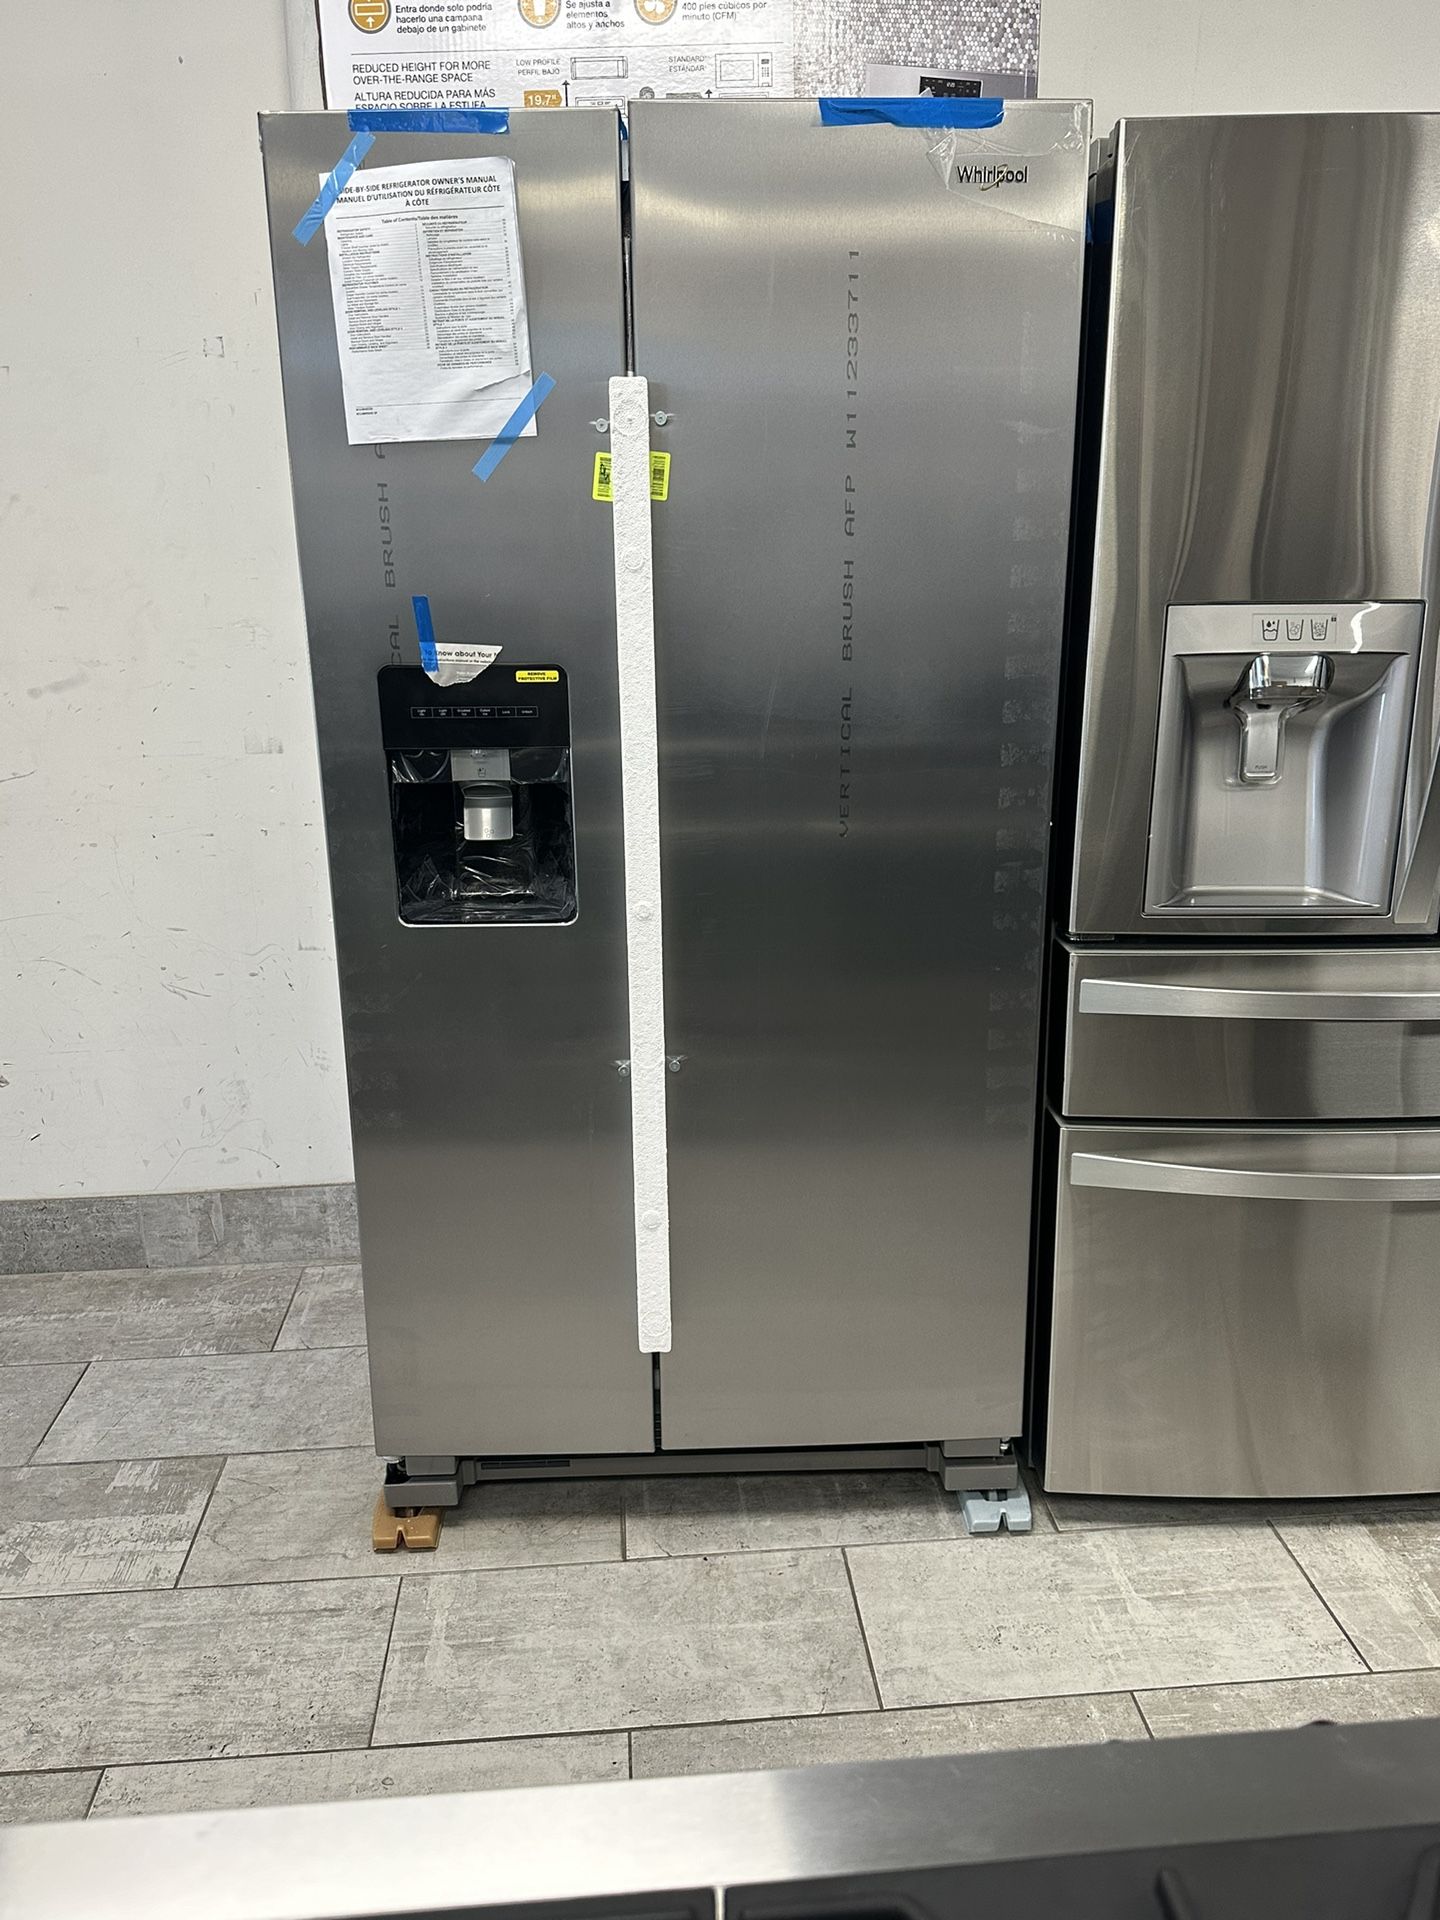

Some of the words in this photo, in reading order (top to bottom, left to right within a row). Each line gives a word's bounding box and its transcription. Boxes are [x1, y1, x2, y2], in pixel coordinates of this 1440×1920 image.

[395, 5, 417, 13] Entra
[419, 4, 445, 13] donde
[447, 3, 464, 12] solo
[565, 0, 577, 9] Se
[578, 1, 603, 9] ajusta
[681, 2, 697, 10] 400
[699, 2, 716, 11] pies
[752, 2, 767, 11] por
[396, 15, 426, 23] hacerlo
[445, 14, 483, 23] campana
[712, 11, 737, 21] (CFM)
[396, 25, 425, 35] debajo
[426, 25, 437, 33] de
[451, 24, 487, 33] gabinete
[566, 21, 586, 29] altos
[588, 22, 593, 30] y
[595, 20, 625, 28] anchos
[352, 63, 399, 73] REDUCED
[401, 62, 437, 72] HEIGHT
[440, 61, 460, 71] FOR
[462, 60, 491, 70] MORE
[533, 58, 560, 66] PROFILE
[353, 73, 439, 85] OVER-THE-RANGE
[441, 73, 473, 82] SPACE
[354, 92, 392, 101] ALTURA
[394, 90, 443, 100] REDUCIDA
[445, 89, 472, 99] PARA
[474, 87, 496, 98] MÁS
[957, 165, 1028, 188] Whirlpool
[340, 184, 381, 195] IDE-BY-SIDE
[382, 179, 430, 190] REFRIGERATOR
[432, 176, 465, 186] OWNER'S
[466, 175, 497, 184] MANUAL
[336, 195, 365, 204] MANUEL
[366, 190, 413, 202] D'UTILISATION
[414, 189, 425, 197] DU
[426, 186, 482, 196] RÉFRIGÉRATEUR
[483, 184, 501, 193] CÔTE
[411, 198, 430, 207] CÔTE
[846, 250, 860, 449] W11233711
[844, 474, 856, 537] AFP
[377, 482, 396, 588] BRUSH
[841, 560, 854, 662] BRUSH
[839, 688, 853, 838] VERTICAL
